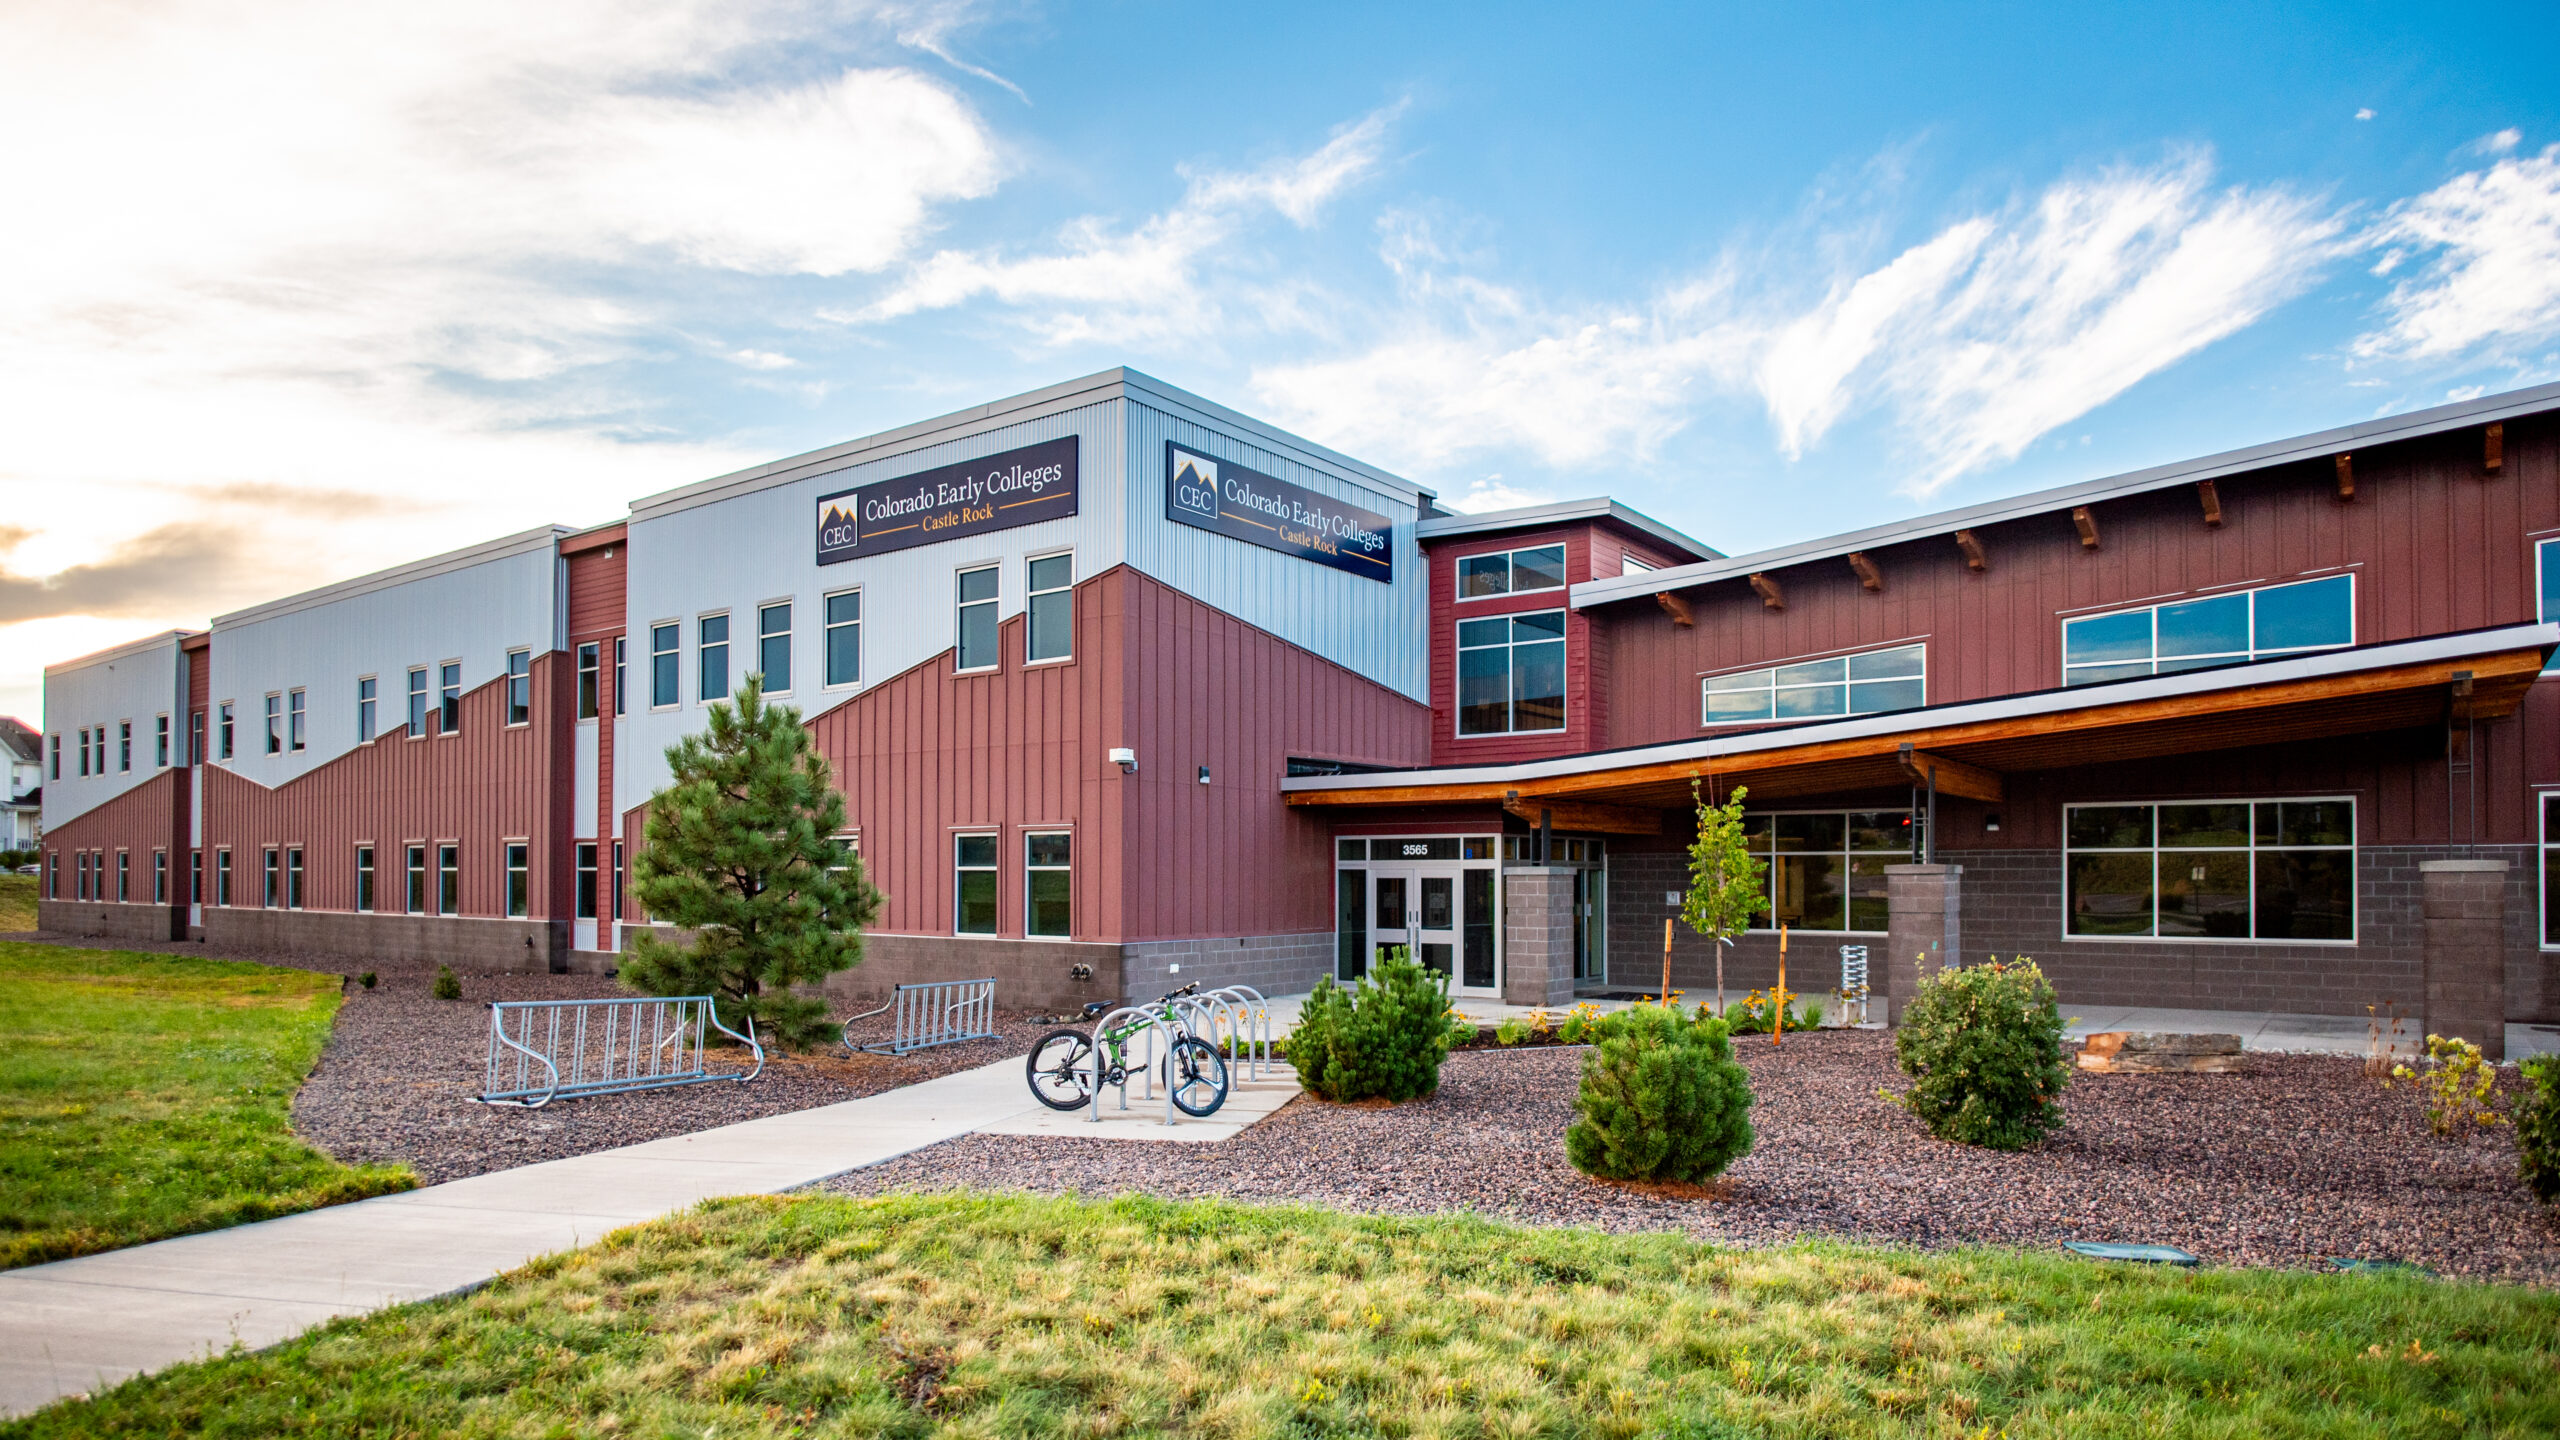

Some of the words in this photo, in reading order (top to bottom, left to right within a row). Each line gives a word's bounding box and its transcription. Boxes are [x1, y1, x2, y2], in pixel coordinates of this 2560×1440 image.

[866, 487, 934, 522] Colorado
[937, 475, 984, 506] Early
[987, 463, 1062, 493] Colleges
[1179, 484, 1212, 511] CEC
[923, 510, 959, 532] Castle
[962, 503, 994, 525] Rock
[1225, 478, 1290, 519] Colorado
[1292, 501, 1331, 537] Early
[1332, 515, 1385, 552] Colleges
[824, 524, 852, 547] CEC
[1279, 525, 1311, 548] Castle
[1313, 535, 1338, 556] Rock
[1402, 844, 1428, 855] 3565
